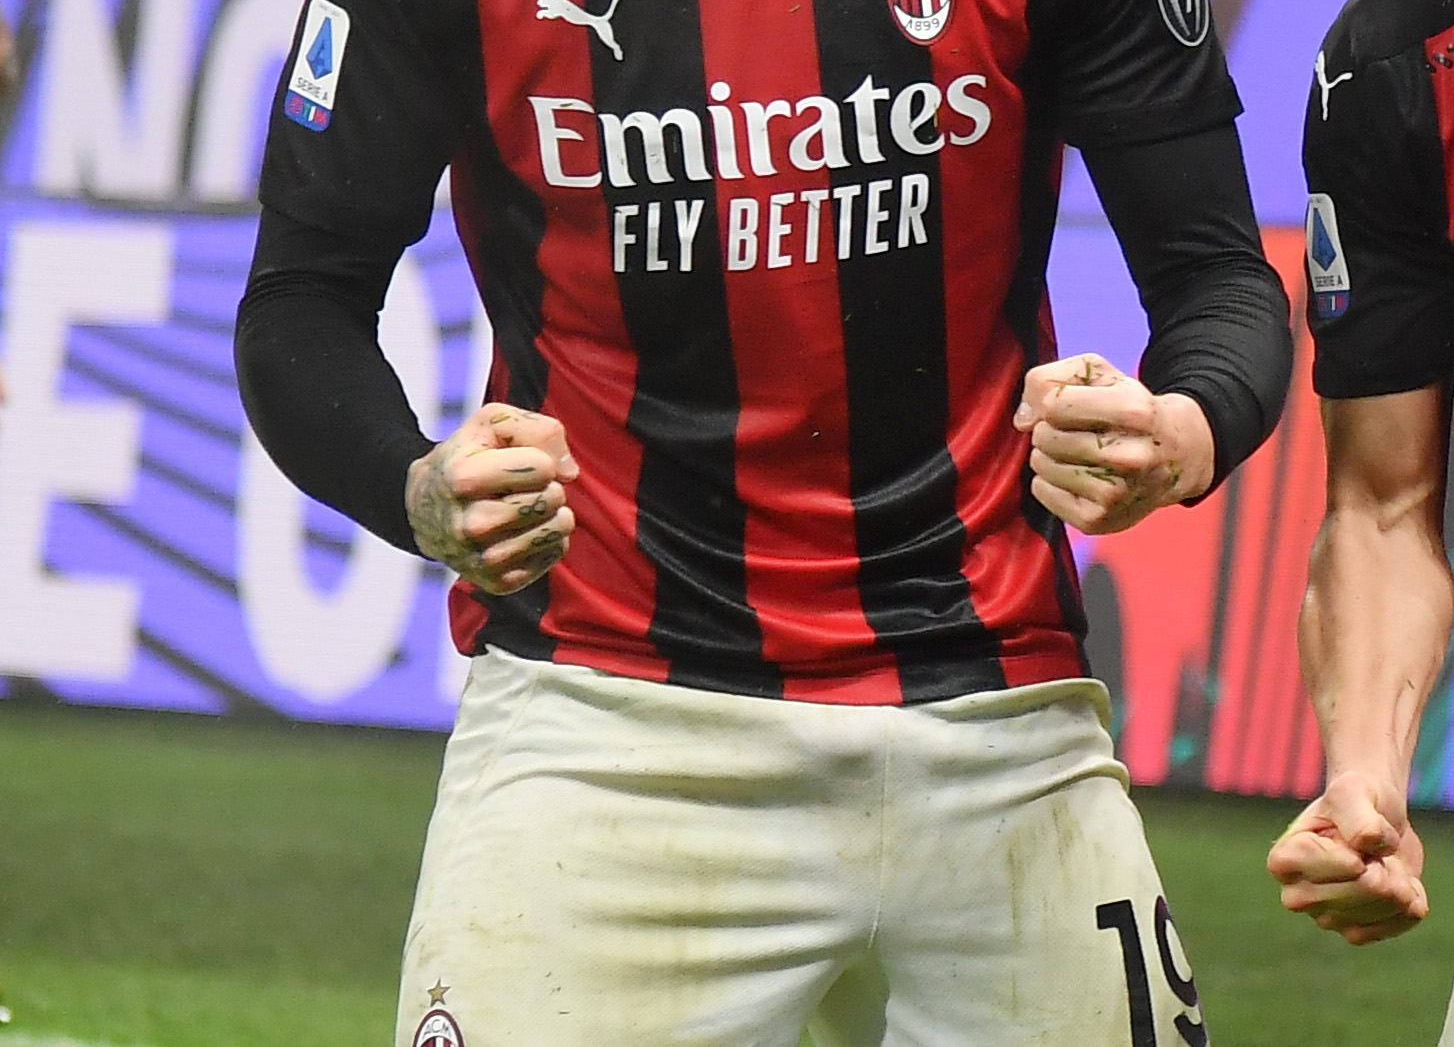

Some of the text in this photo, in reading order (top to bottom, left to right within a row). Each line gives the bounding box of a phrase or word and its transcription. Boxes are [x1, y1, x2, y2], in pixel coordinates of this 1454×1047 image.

[904, 17, 940, 32] 1899
[527, 74, 992, 188] Emirates
[613, 173, 930, 273] FLY BETTER
